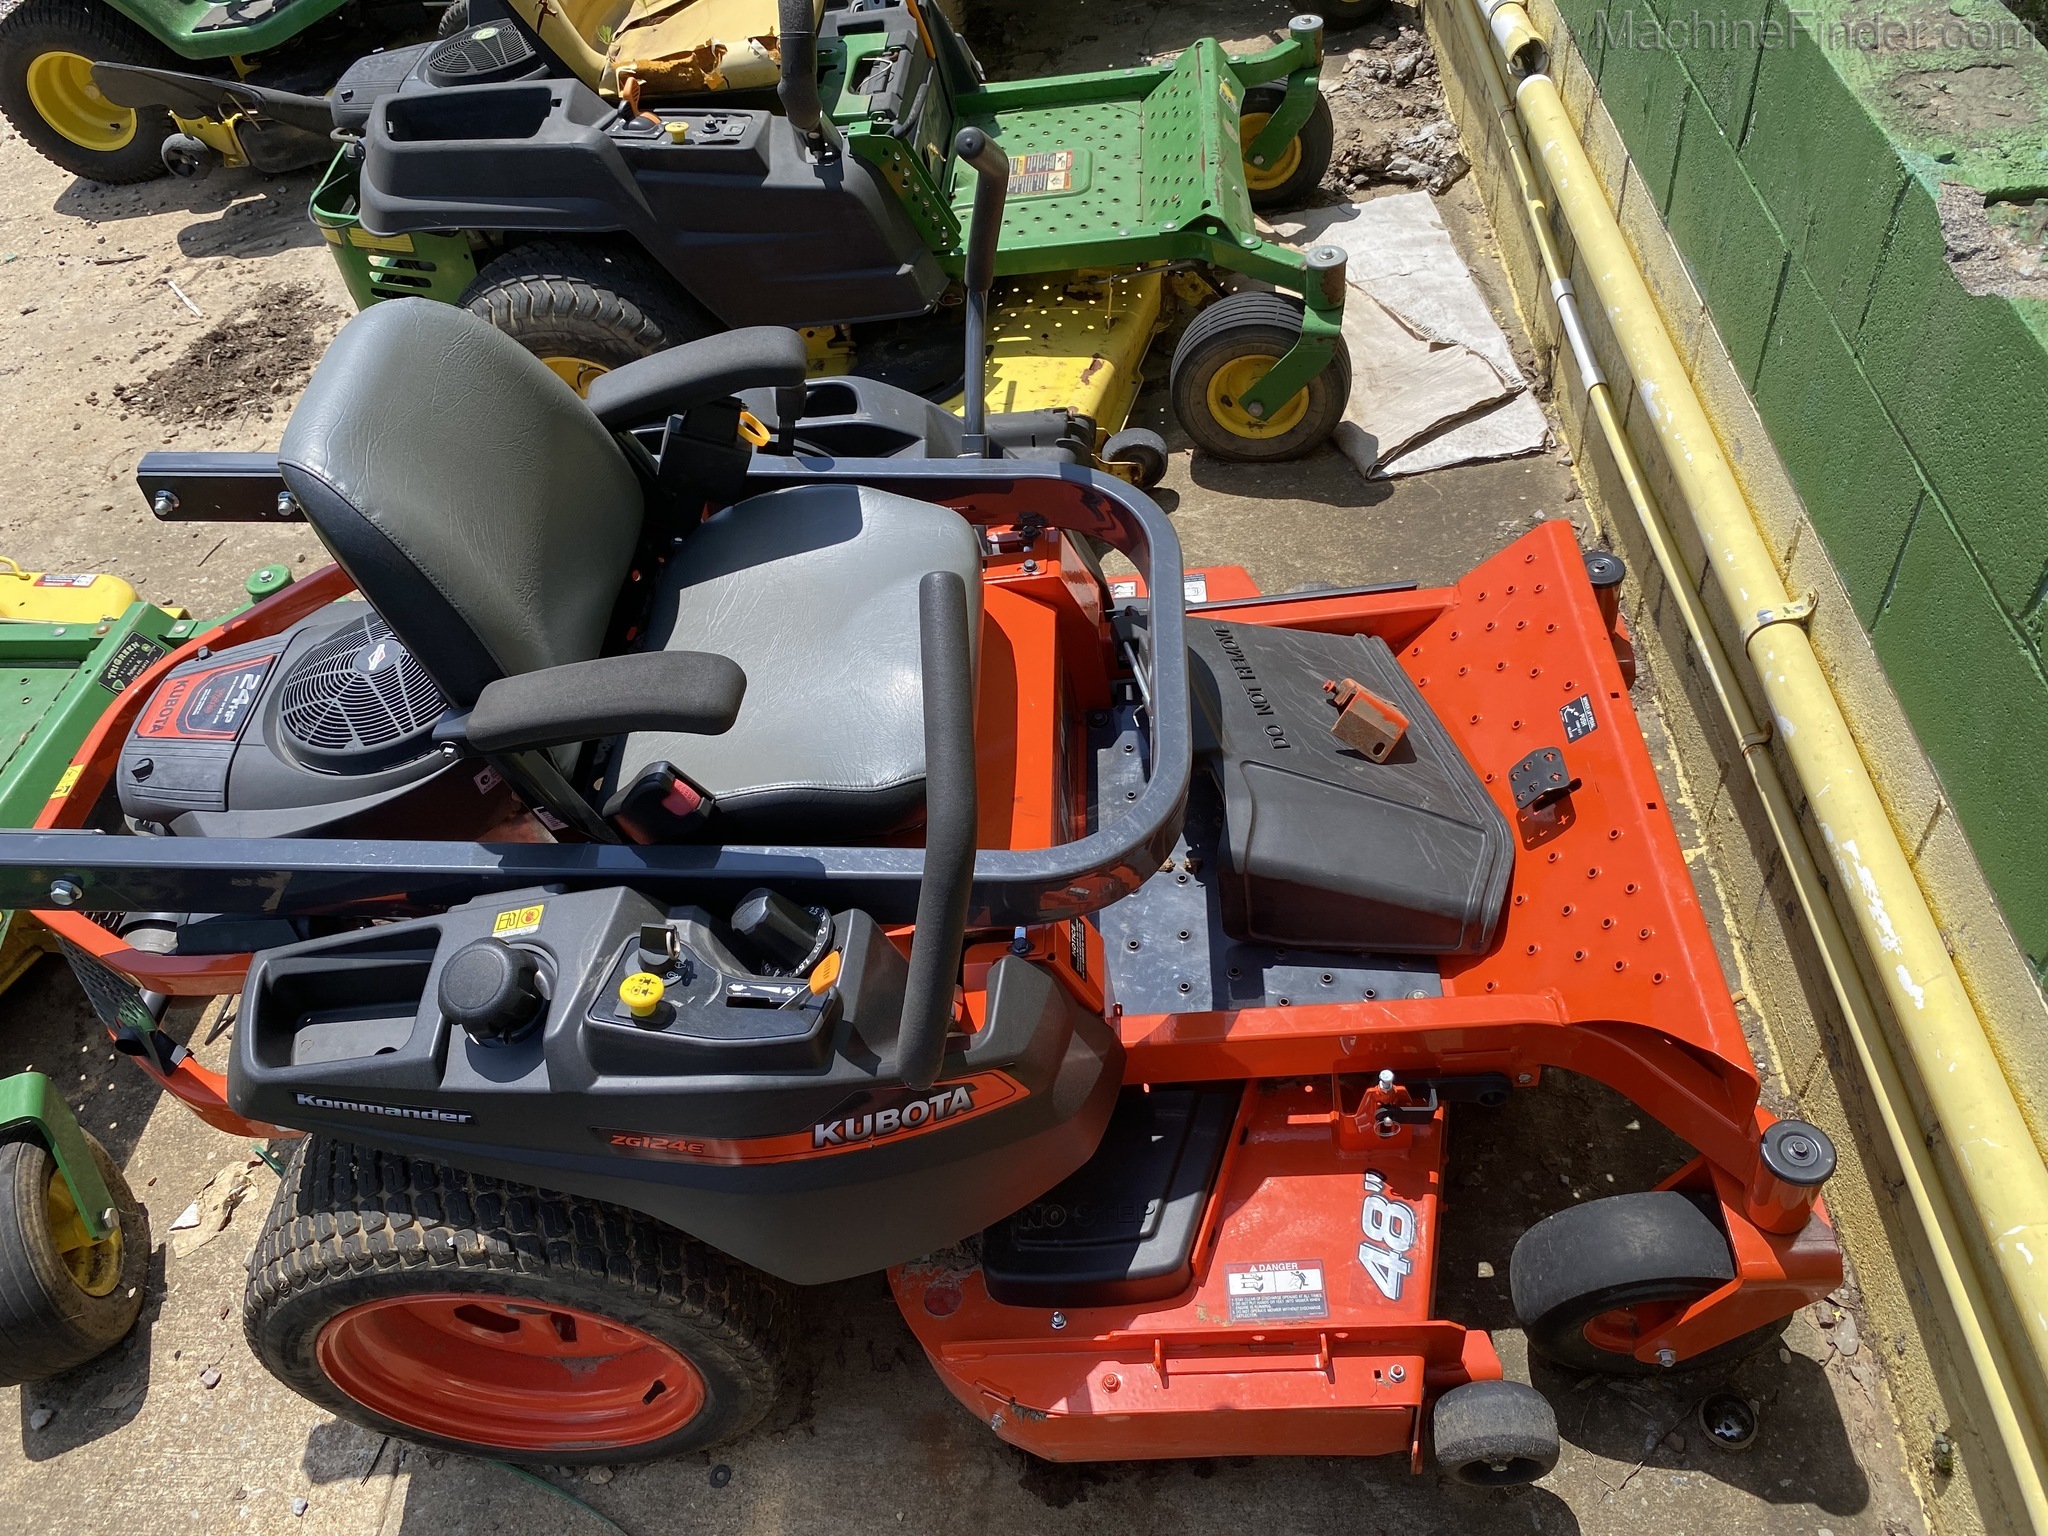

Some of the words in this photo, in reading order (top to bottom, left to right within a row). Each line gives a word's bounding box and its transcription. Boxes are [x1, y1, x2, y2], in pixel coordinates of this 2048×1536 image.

[107, 641, 140, 679] TRIGREEN
[1210, 624, 1256, 679] REMOVE
[149, 679, 189, 733] KUBOTA
[1242, 684, 1275, 715] NOT
[1263, 724, 1291, 749] DO
[817, 927, 827, 936] 2
[296, 1094, 472, 1124] Kommander
[813, 1086, 973, 1148] KUBOTA
[610, 1134, 705, 1154] ZG124E
[1020, 1203, 1067, 1229] NO
[1074, 1201, 1156, 1226] STEP
[1258, 1262, 1298, 1272] DANGER
